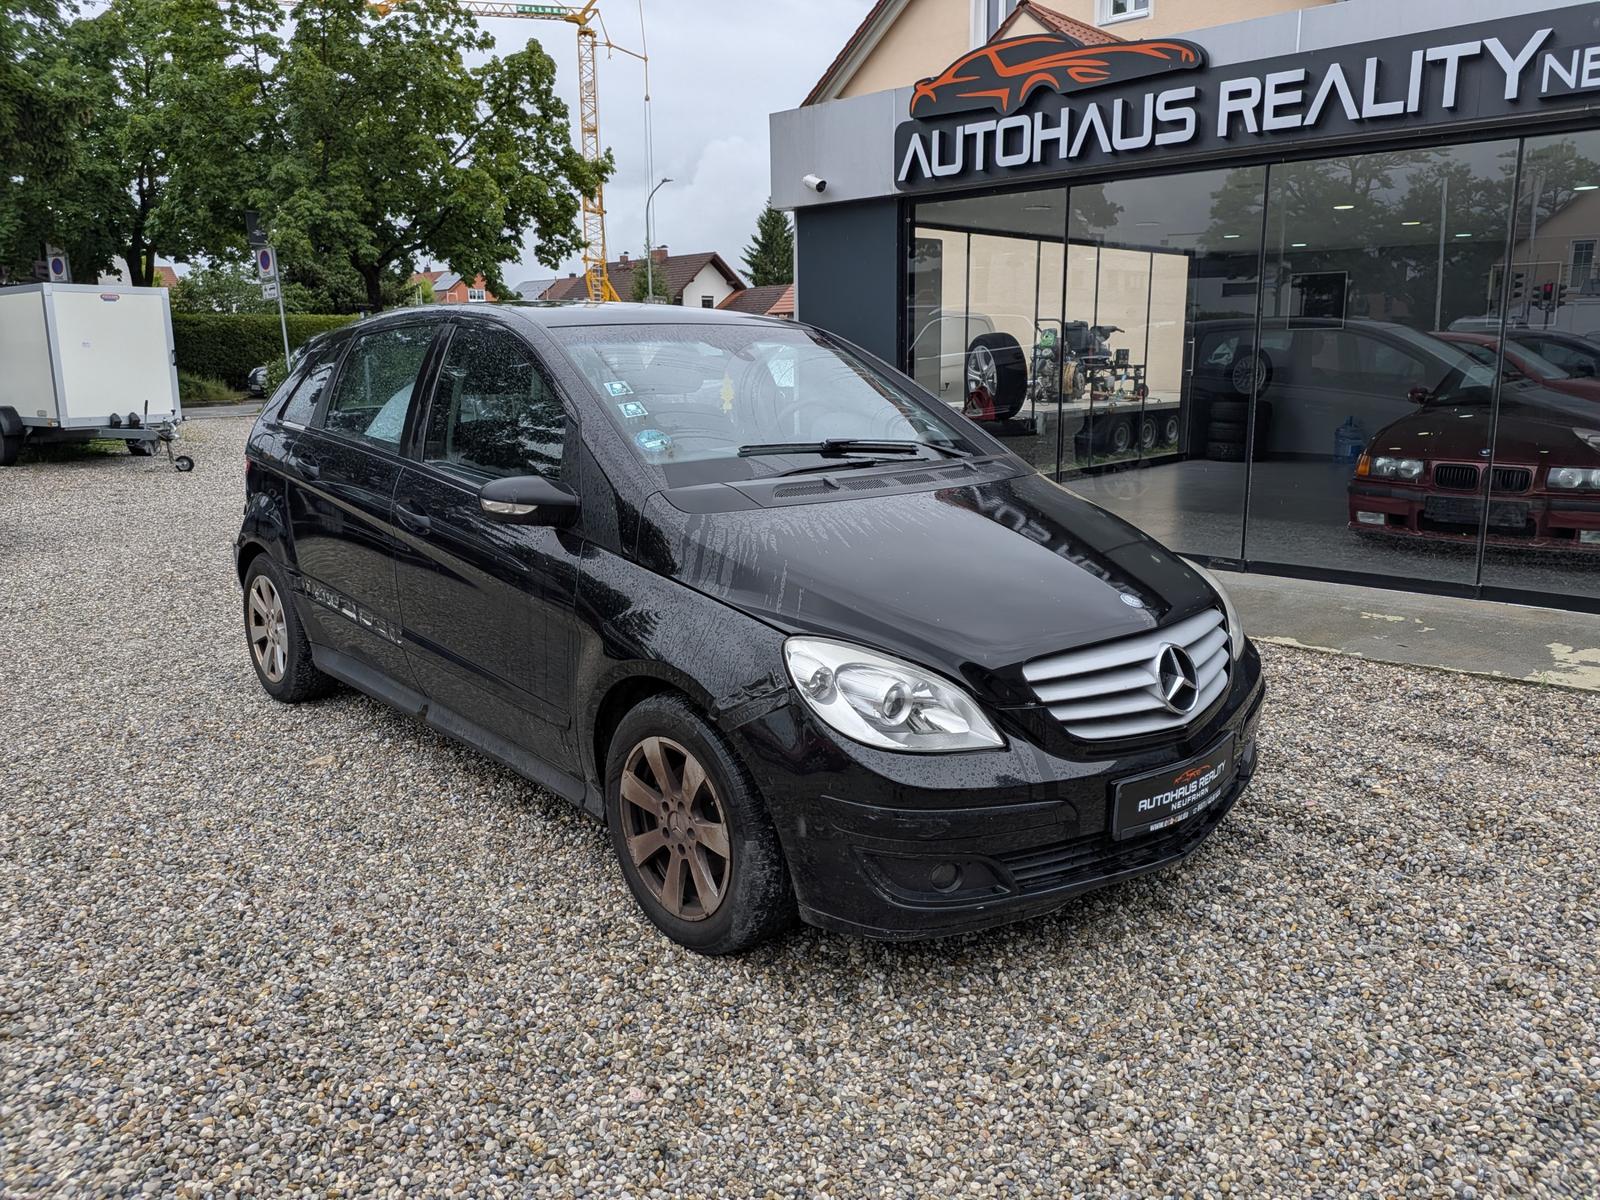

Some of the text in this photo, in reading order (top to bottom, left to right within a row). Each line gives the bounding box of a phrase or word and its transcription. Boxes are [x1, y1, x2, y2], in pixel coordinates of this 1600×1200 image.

[897, 27, 1553, 182] AUTOHAUS REALITY
[1138, 781, 1198, 812] AUTOHAUS
[1198, 760, 1226, 789] REALITY
[1171, 786, 1209, 811] NEUFAHRN
